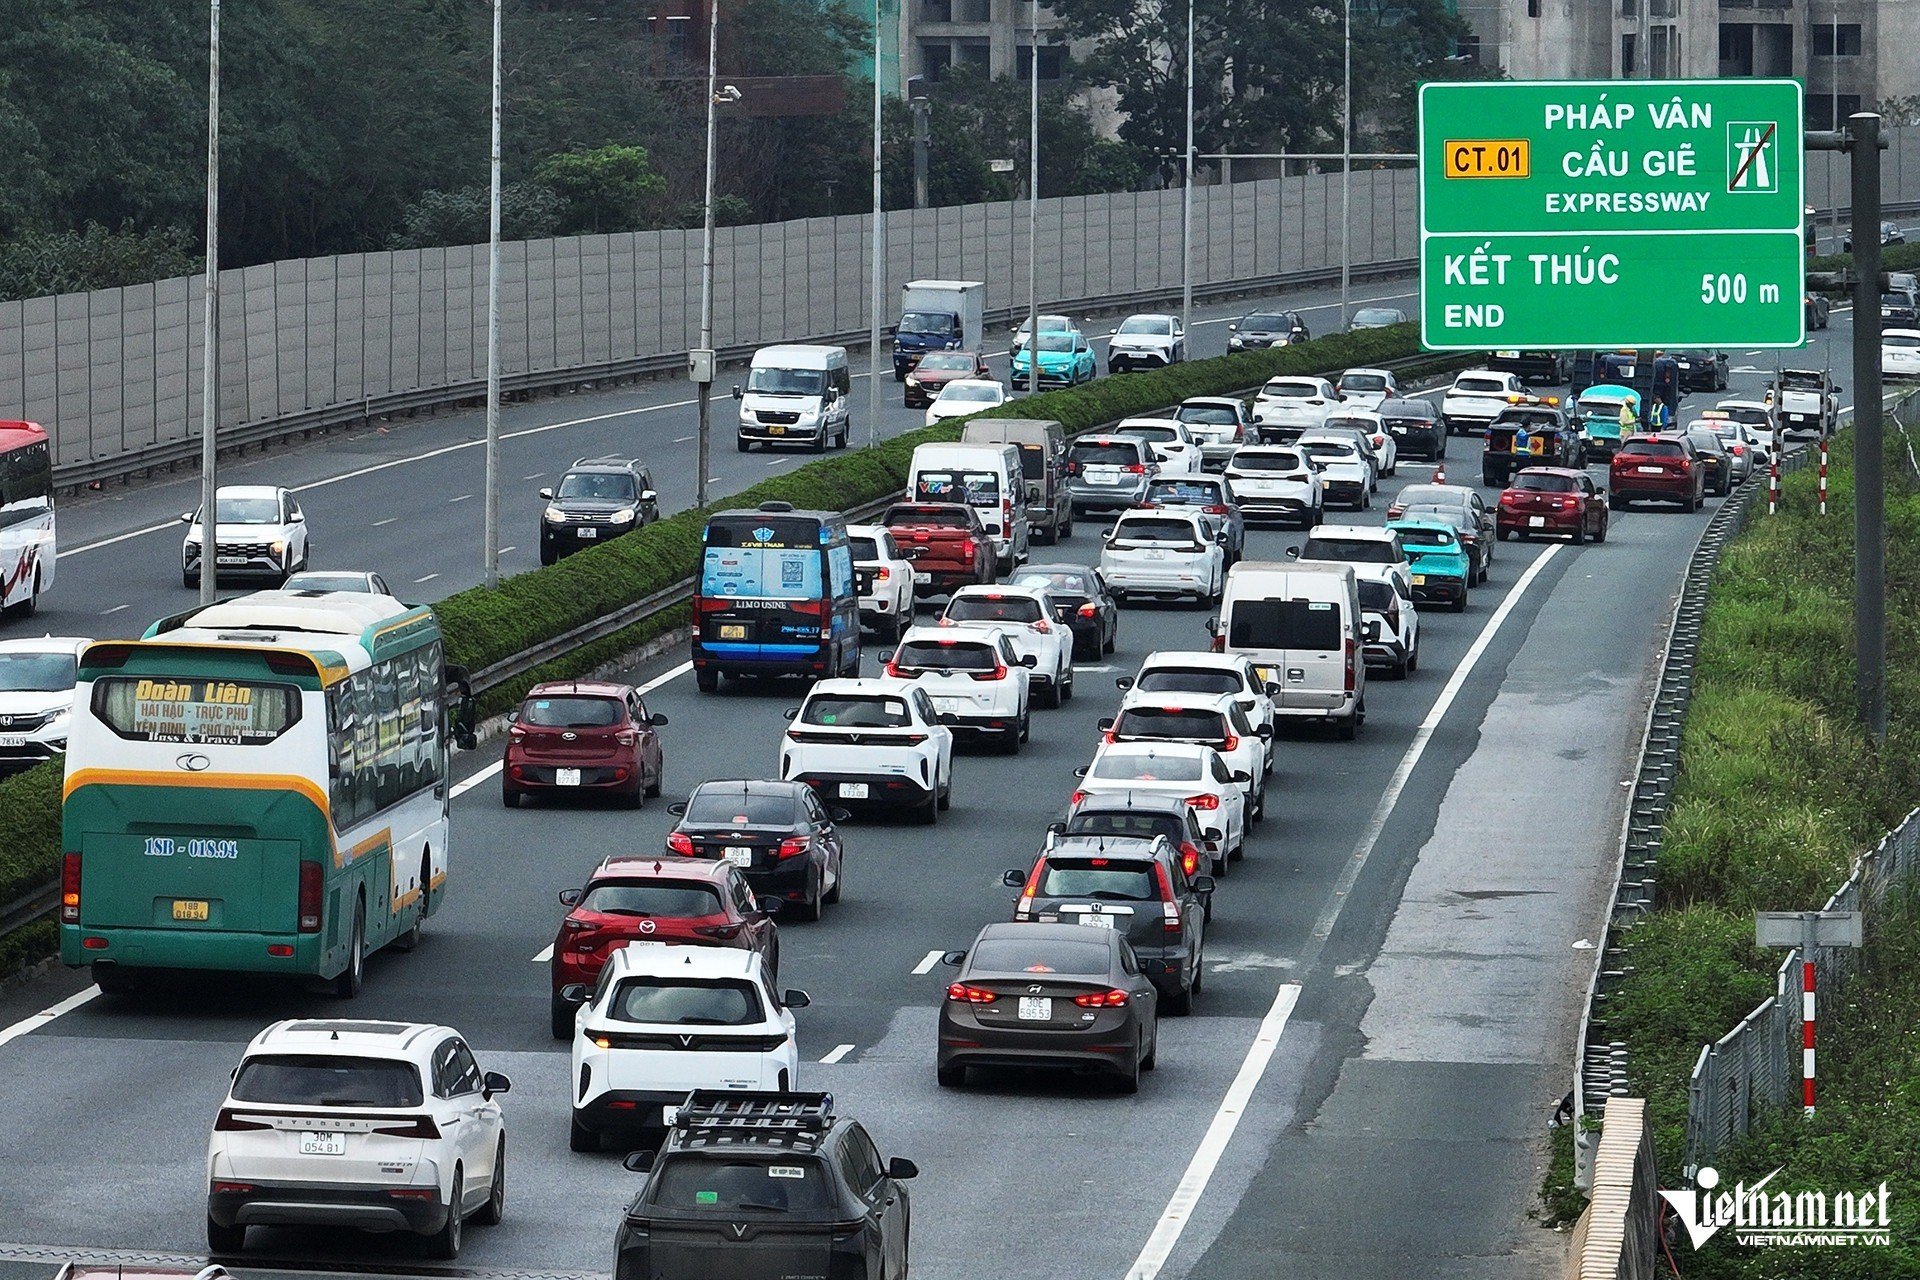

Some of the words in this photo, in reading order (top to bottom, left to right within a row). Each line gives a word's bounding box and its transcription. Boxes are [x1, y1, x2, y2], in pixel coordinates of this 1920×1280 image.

[1545, 93, 1635, 129] PHÁP
[1648, 96, 1712, 129] VÂN
[1454, 146, 1520, 172] CT.01
[1562, 139, 1628, 177] CẦU
[1643, 142, 1697, 177] GIẼ
[1545, 192, 1711, 213] EXPRESSWAY
[1444, 241, 1512, 285] KẾT
[1528, 246, 1620, 285] THÚC
[1701, 273, 1747, 304] 500
[1759, 282, 1780, 304] m
[1444, 304, 1505, 327] END
[135, 679, 192, 701] Đoàn
[204, 682, 252, 704] Liên
[144, 836, 175, 857] 18B
[277, 1120, 369, 1128] HYUNDAI
